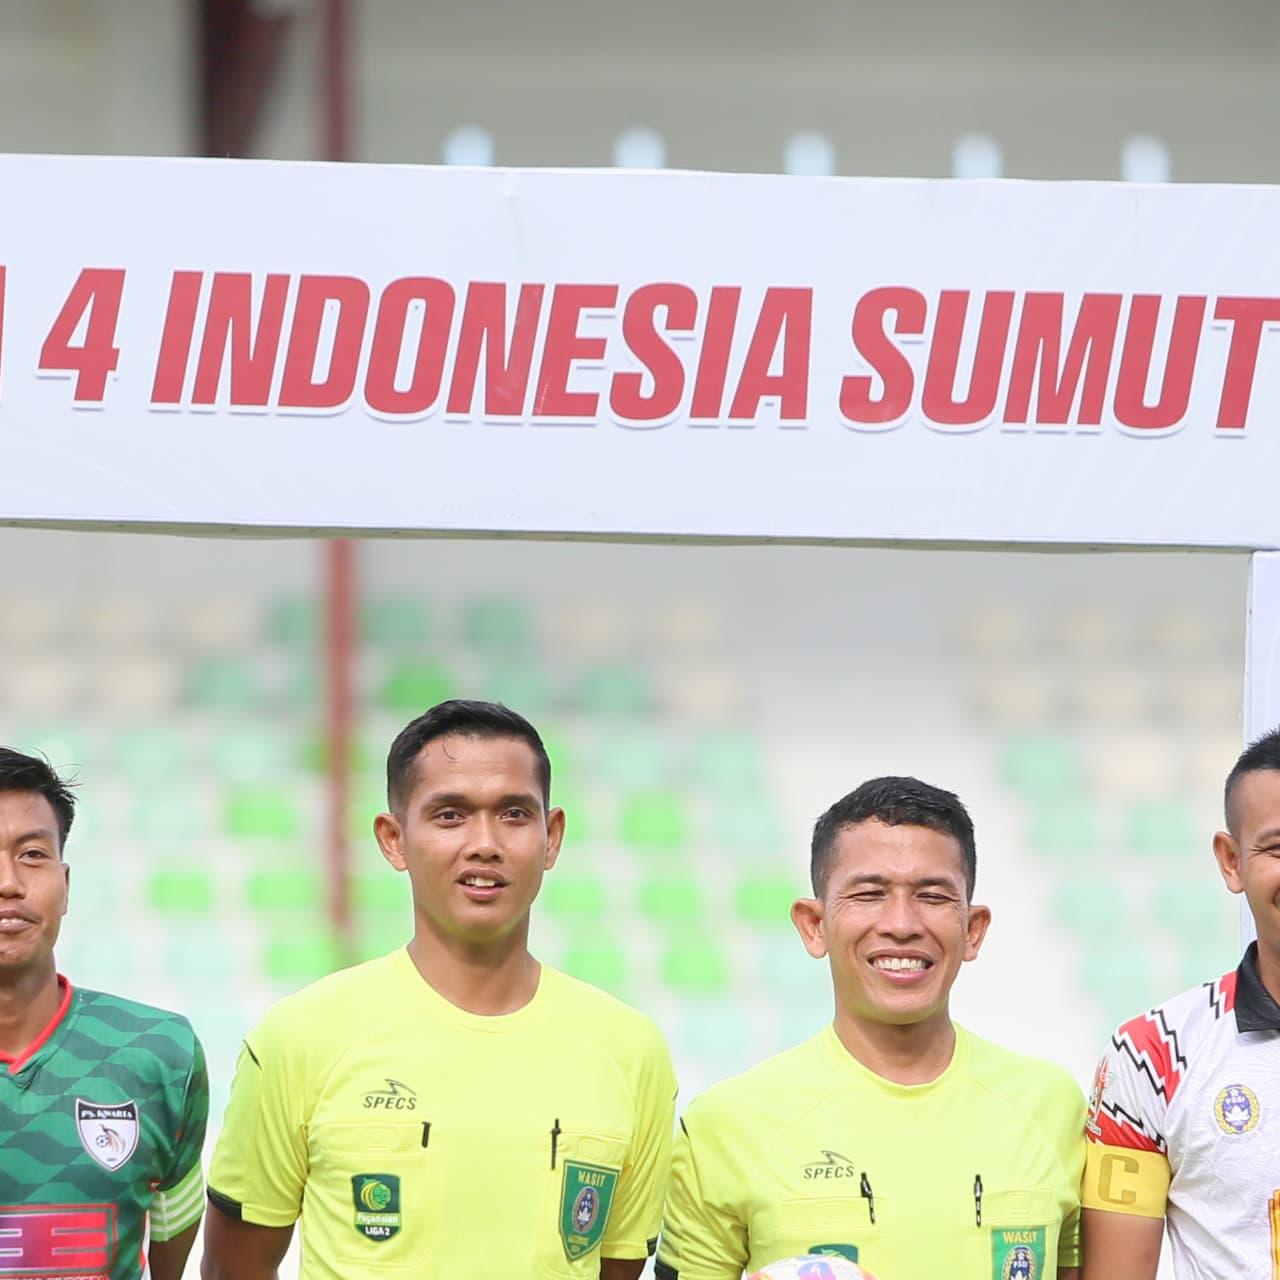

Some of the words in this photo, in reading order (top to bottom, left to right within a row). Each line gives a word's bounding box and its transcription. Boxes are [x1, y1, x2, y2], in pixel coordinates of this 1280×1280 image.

[39, 267, 128, 404] 4
[150, 270, 815, 427] INDONESIA
[363, 1095, 417, 1110] SPECS
[578, 1170, 607, 1188] WASIT
[803, 1165, 855, 1180] SPECS
[1098, 1153, 1140, 1206] C
[364, 1226, 384, 1236] LIGA
[1002, 1231, 1038, 1244] WASIT
